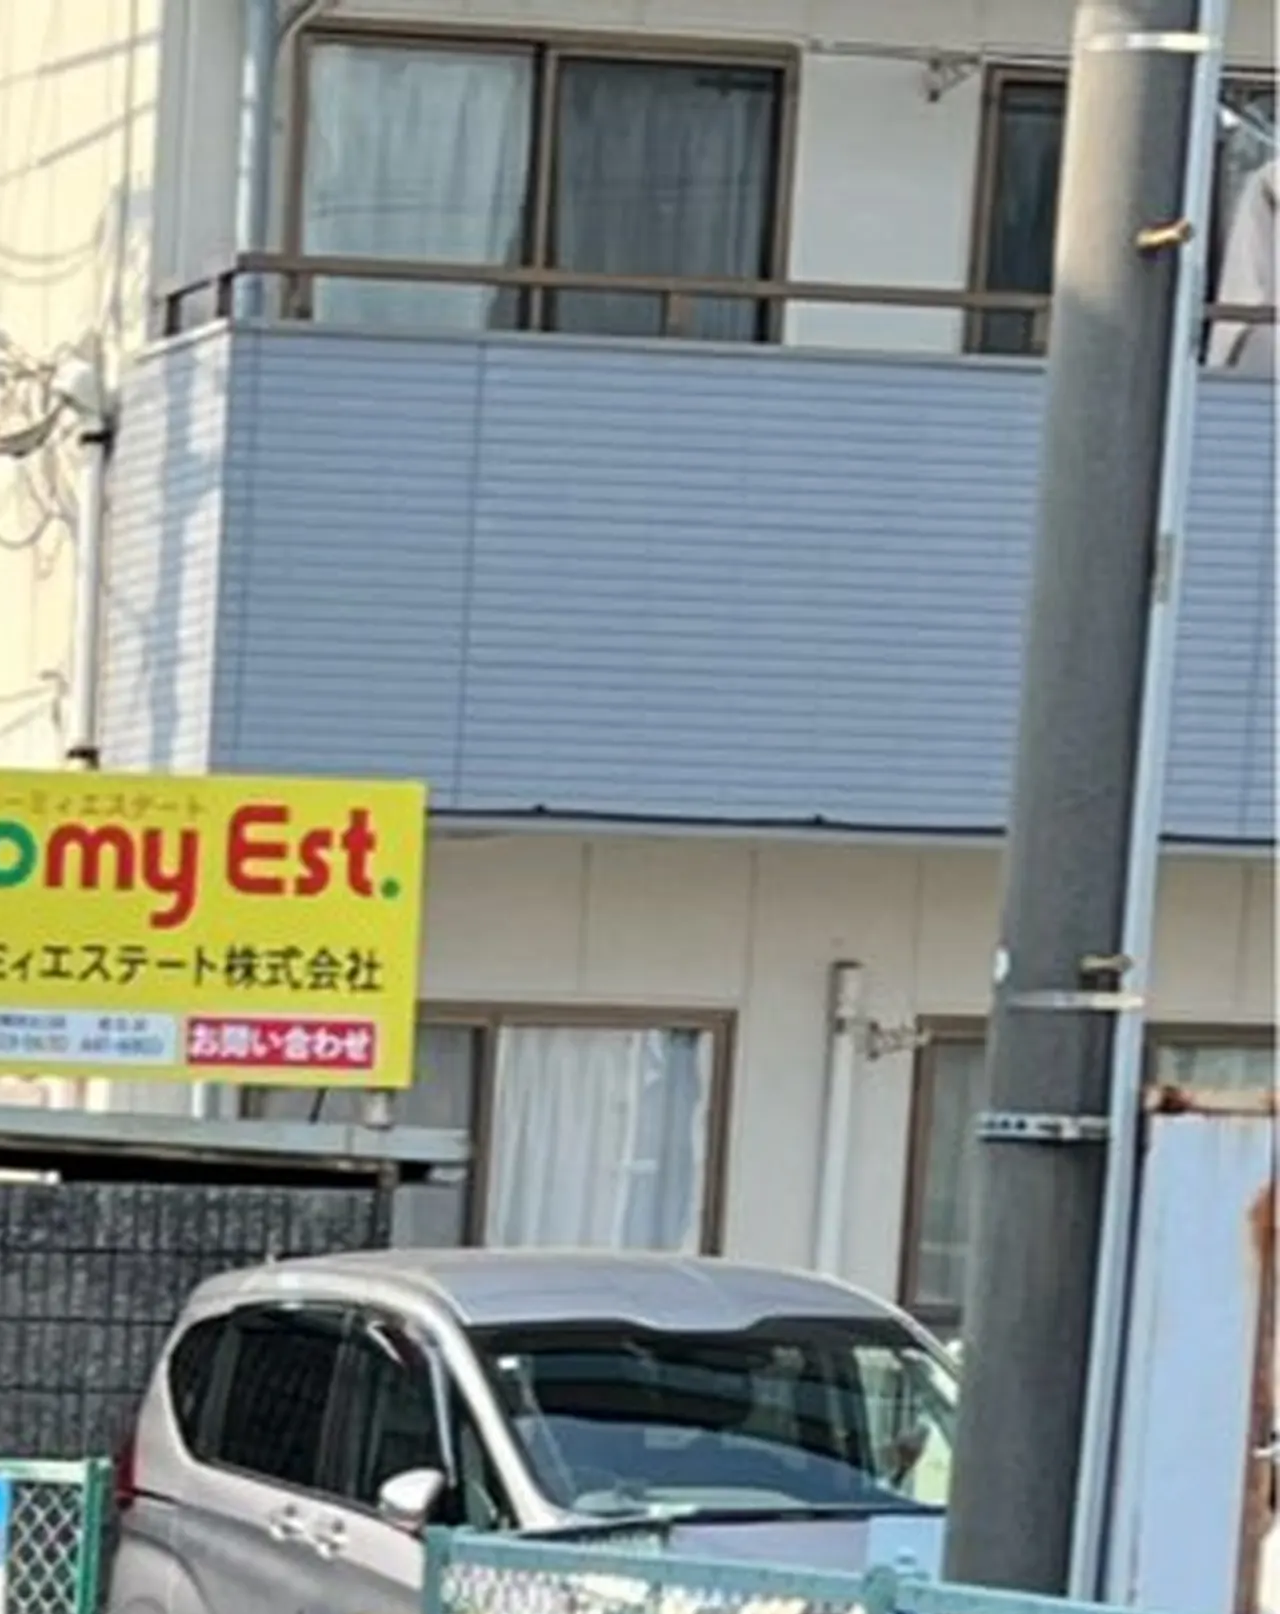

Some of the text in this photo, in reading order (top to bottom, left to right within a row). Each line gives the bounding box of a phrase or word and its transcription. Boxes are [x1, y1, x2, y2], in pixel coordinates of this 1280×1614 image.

[191, 1021, 372, 1064] お問い合わせ
